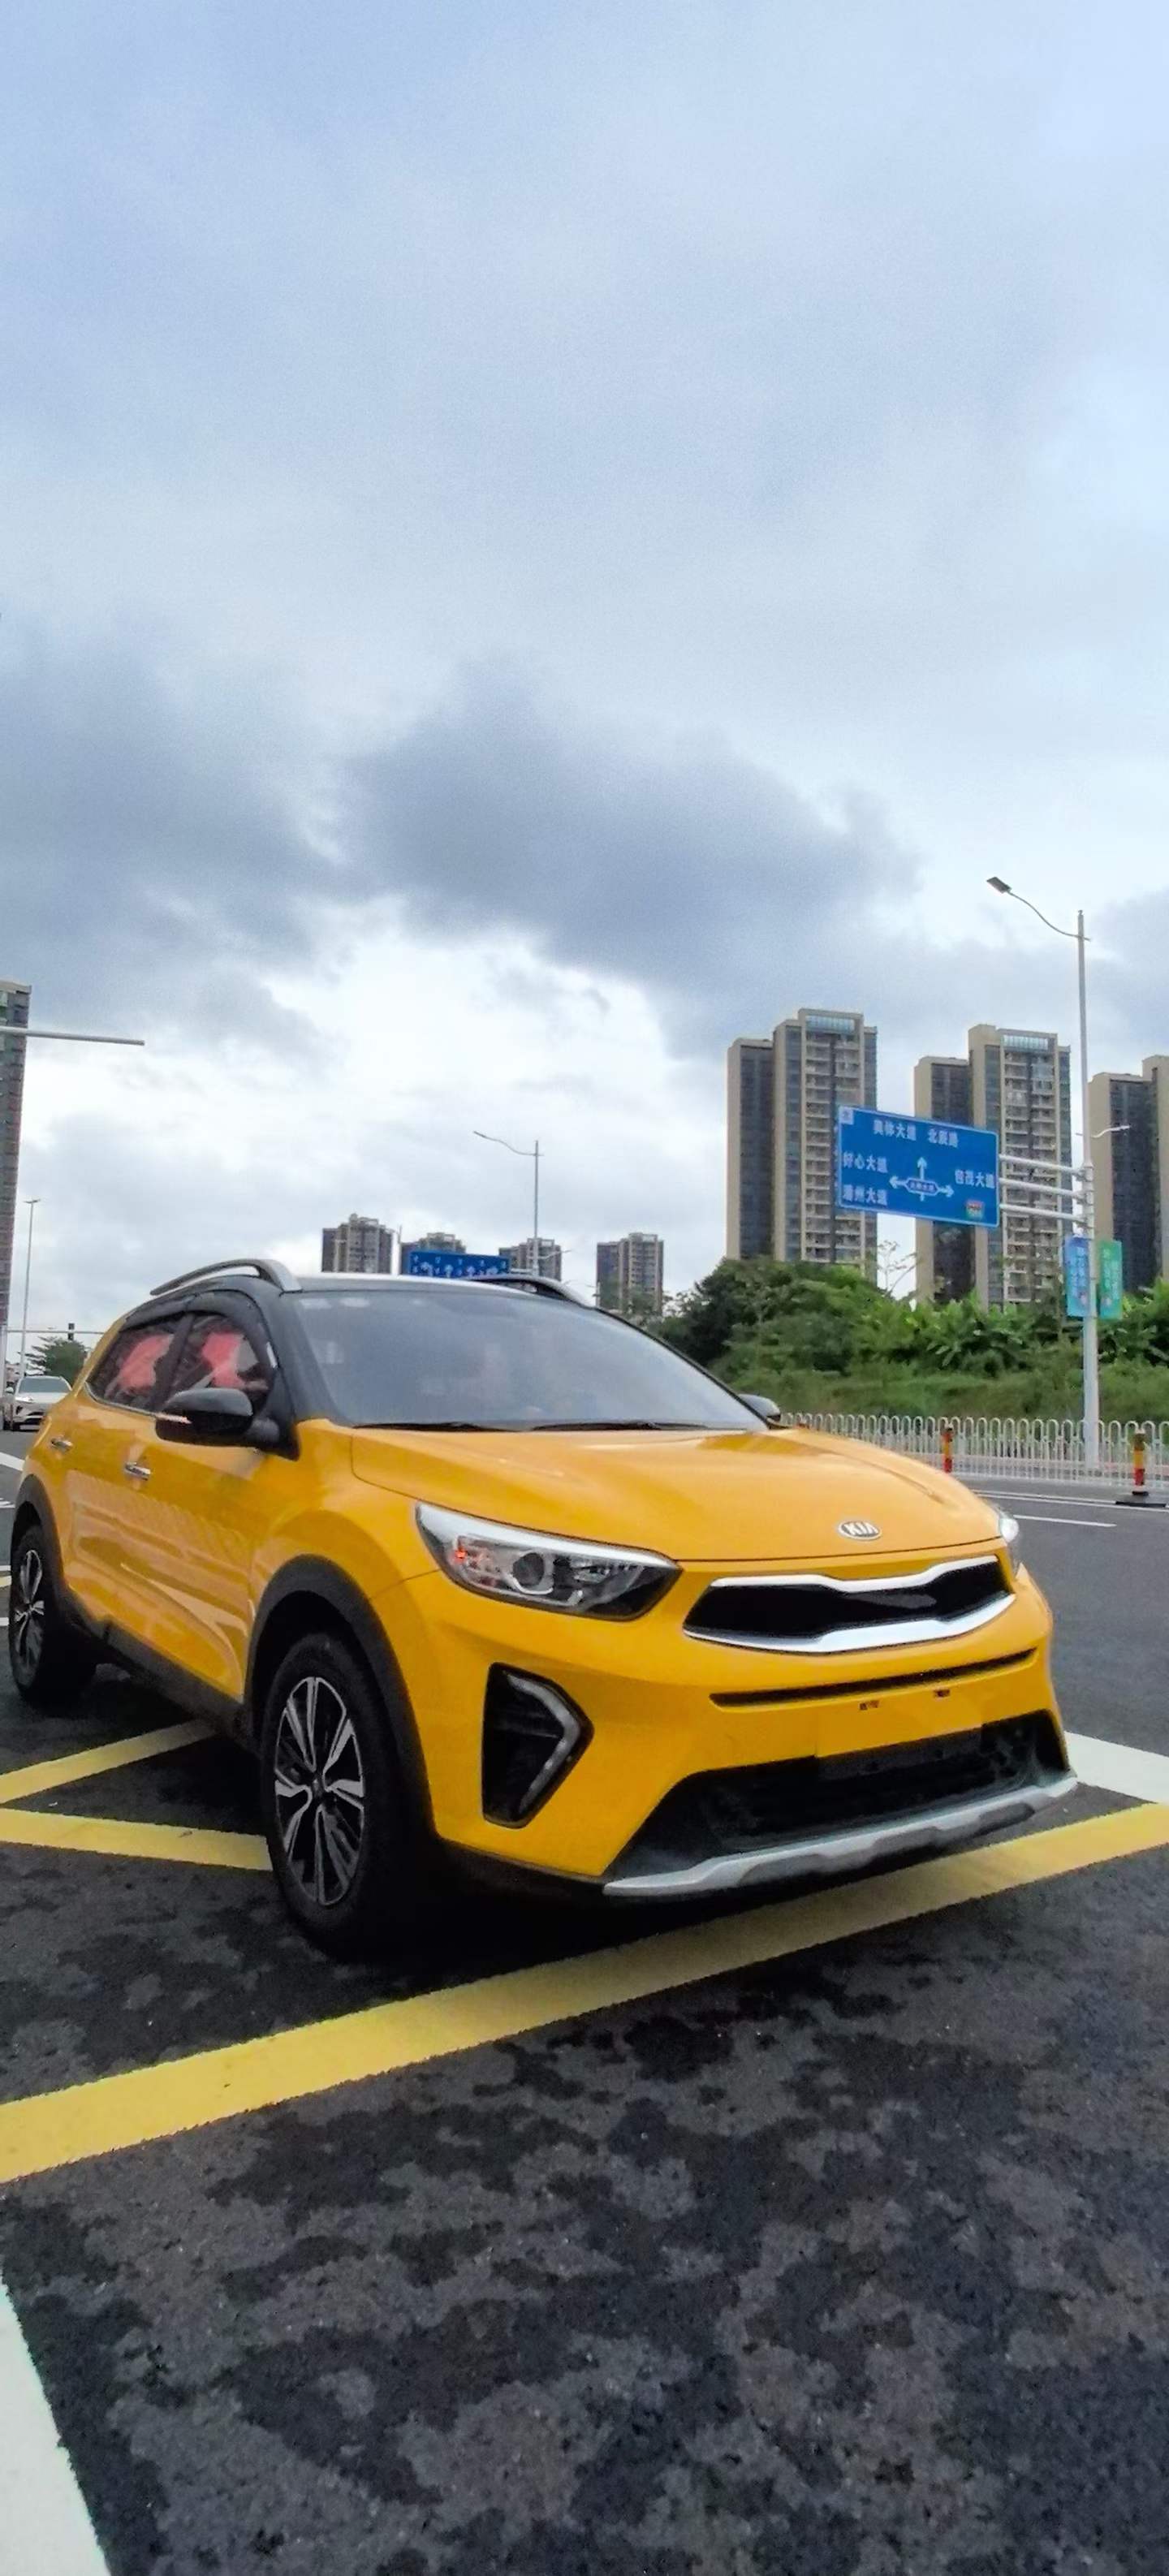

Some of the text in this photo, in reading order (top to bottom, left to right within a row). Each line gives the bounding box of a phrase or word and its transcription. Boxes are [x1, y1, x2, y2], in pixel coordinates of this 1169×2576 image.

[843, 1151, 888, 1173] 好心大道
[842, 1521, 879, 1536] KIA
